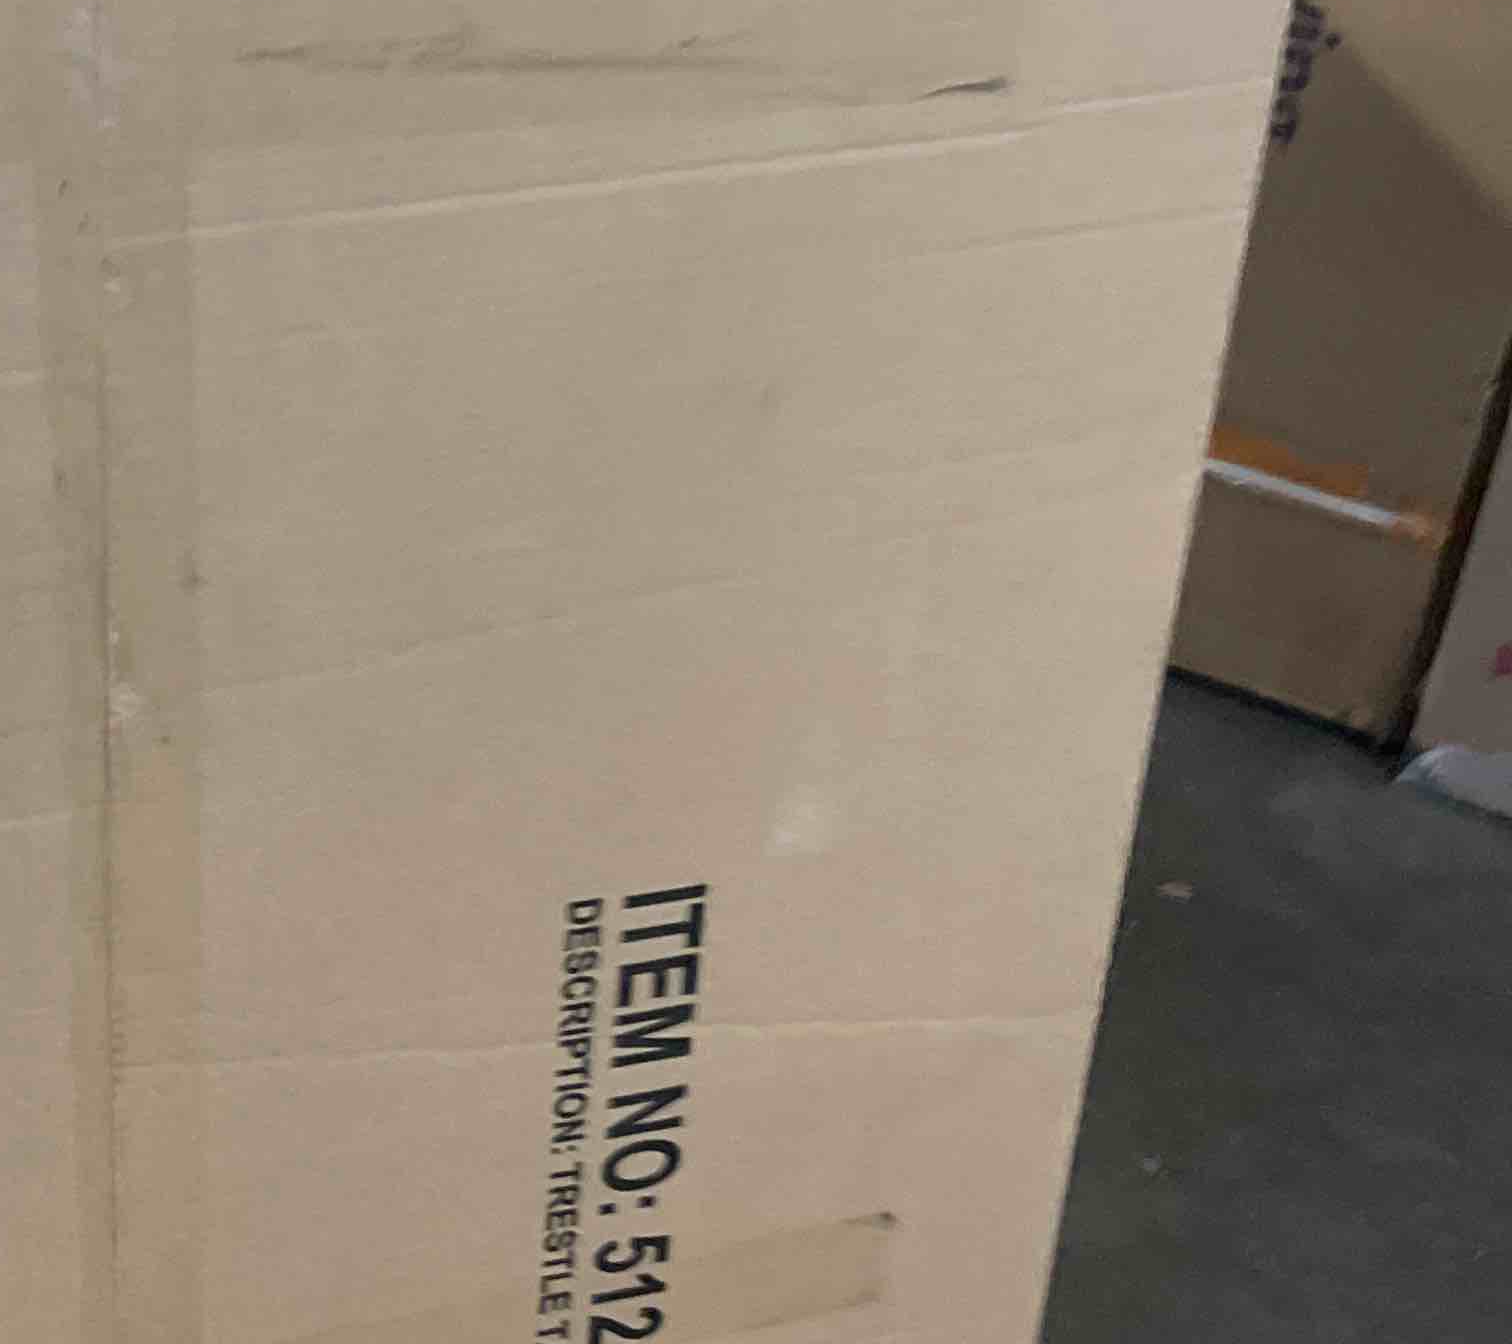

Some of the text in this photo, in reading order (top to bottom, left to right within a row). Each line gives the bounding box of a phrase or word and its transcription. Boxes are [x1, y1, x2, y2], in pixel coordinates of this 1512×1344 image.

[550, 897, 605, 1155] DESCRIPTION:
[611, 882, 708, 1069] ITEM
[597, 1083, 688, 1217] NO:
[538, 1160, 583, 1316] TRESTLE
